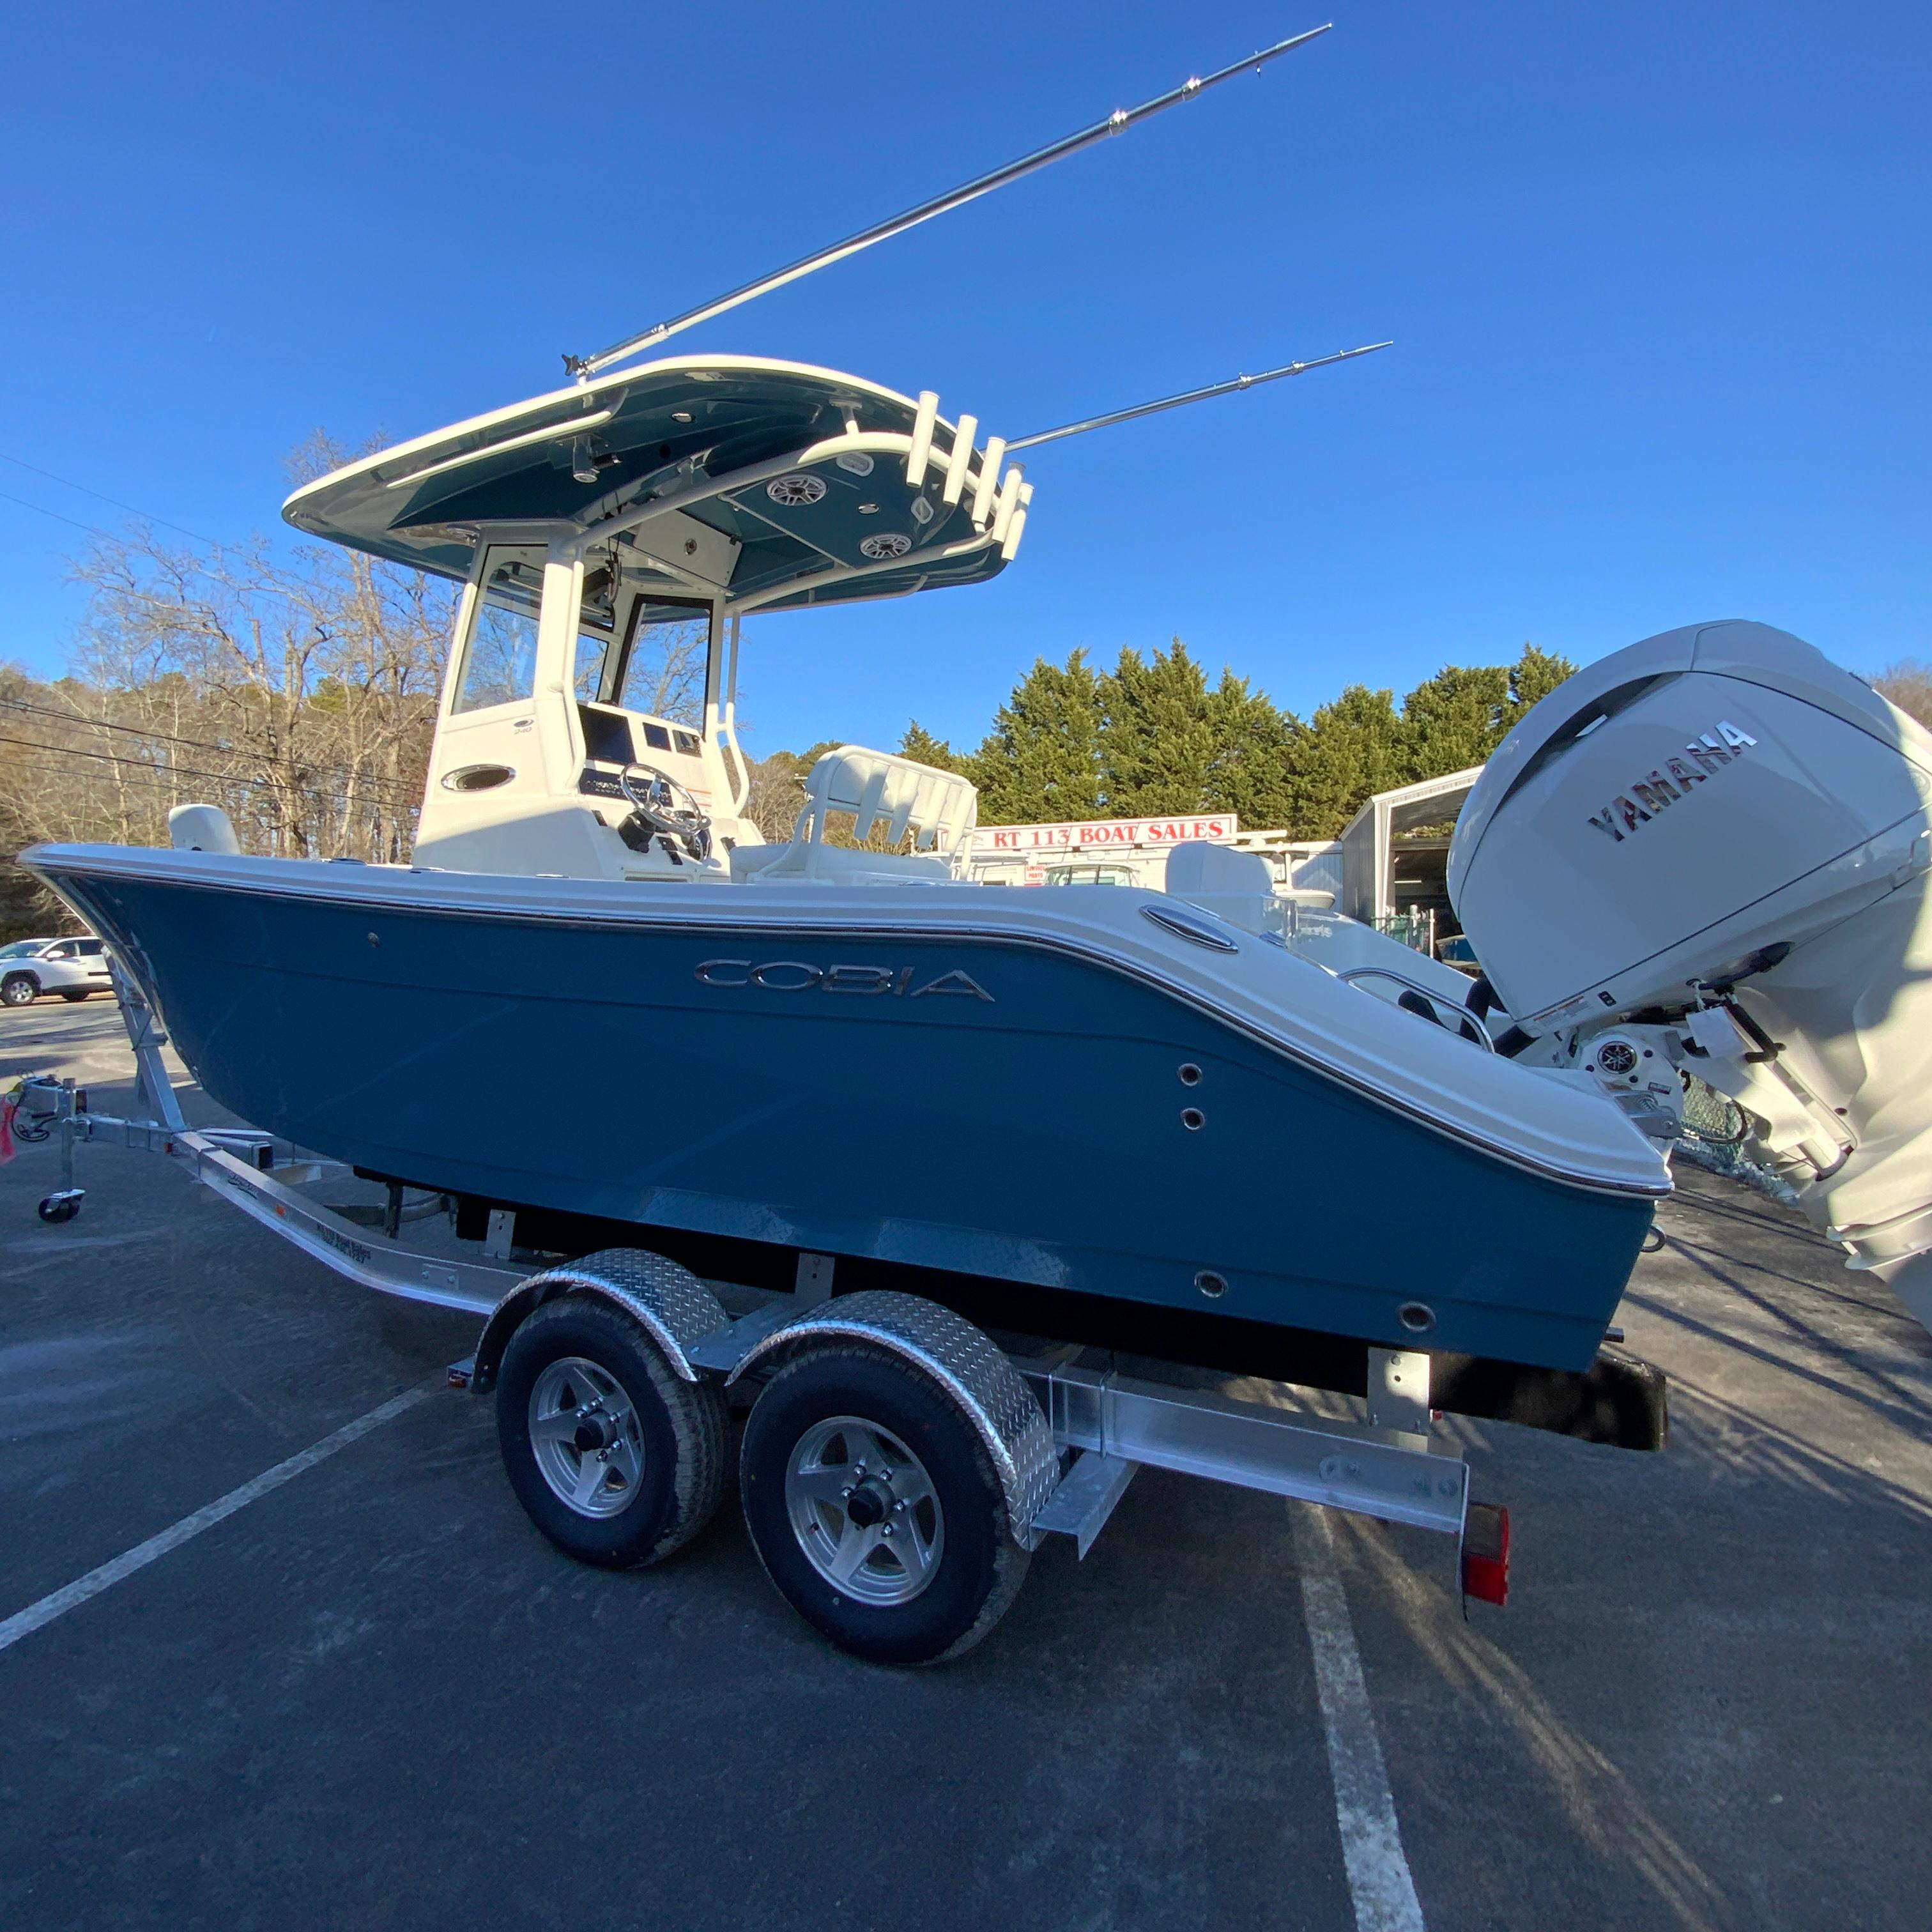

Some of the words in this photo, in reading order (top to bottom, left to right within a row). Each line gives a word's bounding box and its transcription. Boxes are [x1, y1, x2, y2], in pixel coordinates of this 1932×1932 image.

[1587, 720, 1758, 841] YAMAHA
[993, 831, 1021, 847] RT
[1031, 829, 1070, 846] 113
[1079, 825, 1137, 843] BOAT
[1148, 821, 1223, 841] SALES
[694, 958, 996, 1002] COBIA
